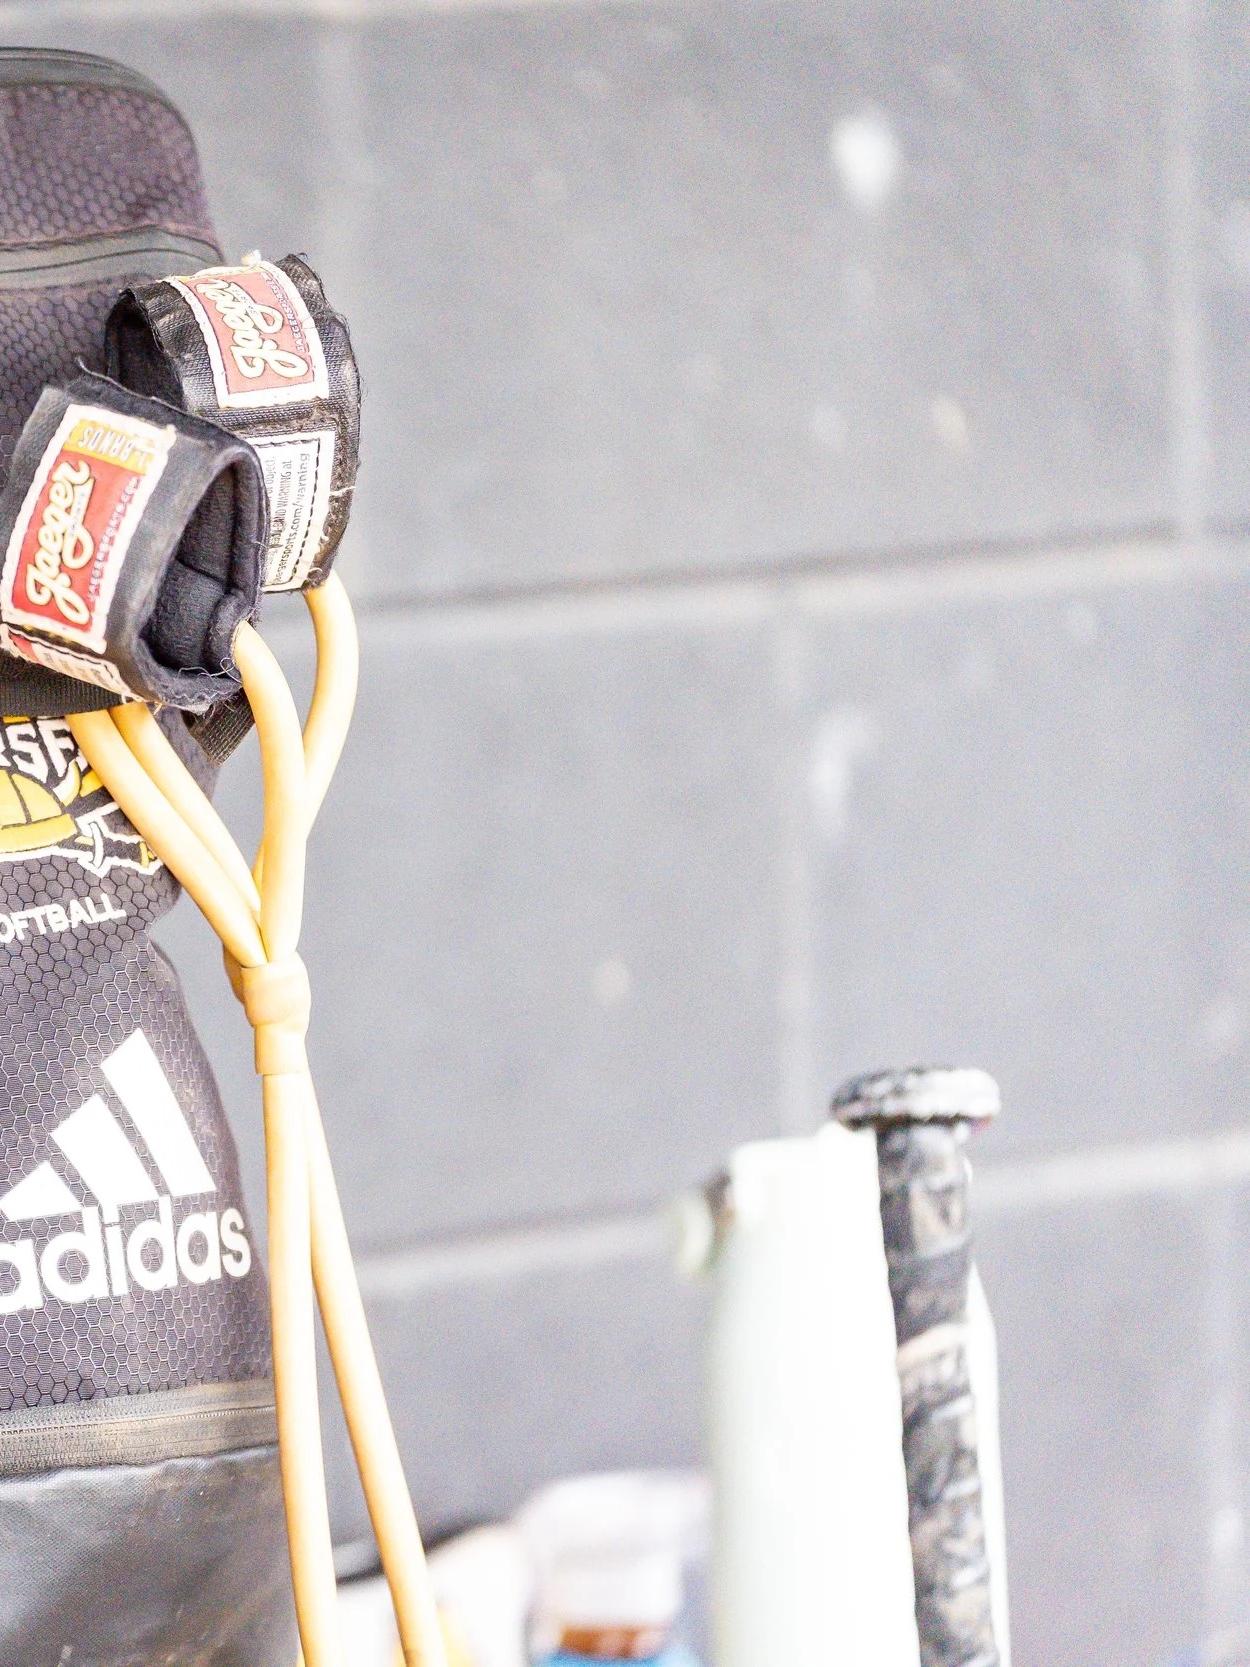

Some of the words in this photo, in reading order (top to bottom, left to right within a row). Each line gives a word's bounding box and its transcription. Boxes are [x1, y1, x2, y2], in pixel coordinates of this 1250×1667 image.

[194, 279, 309, 378] Jaeger
[278, 471, 293, 508] WARNING
[25, 459, 95, 625] Jaeger
